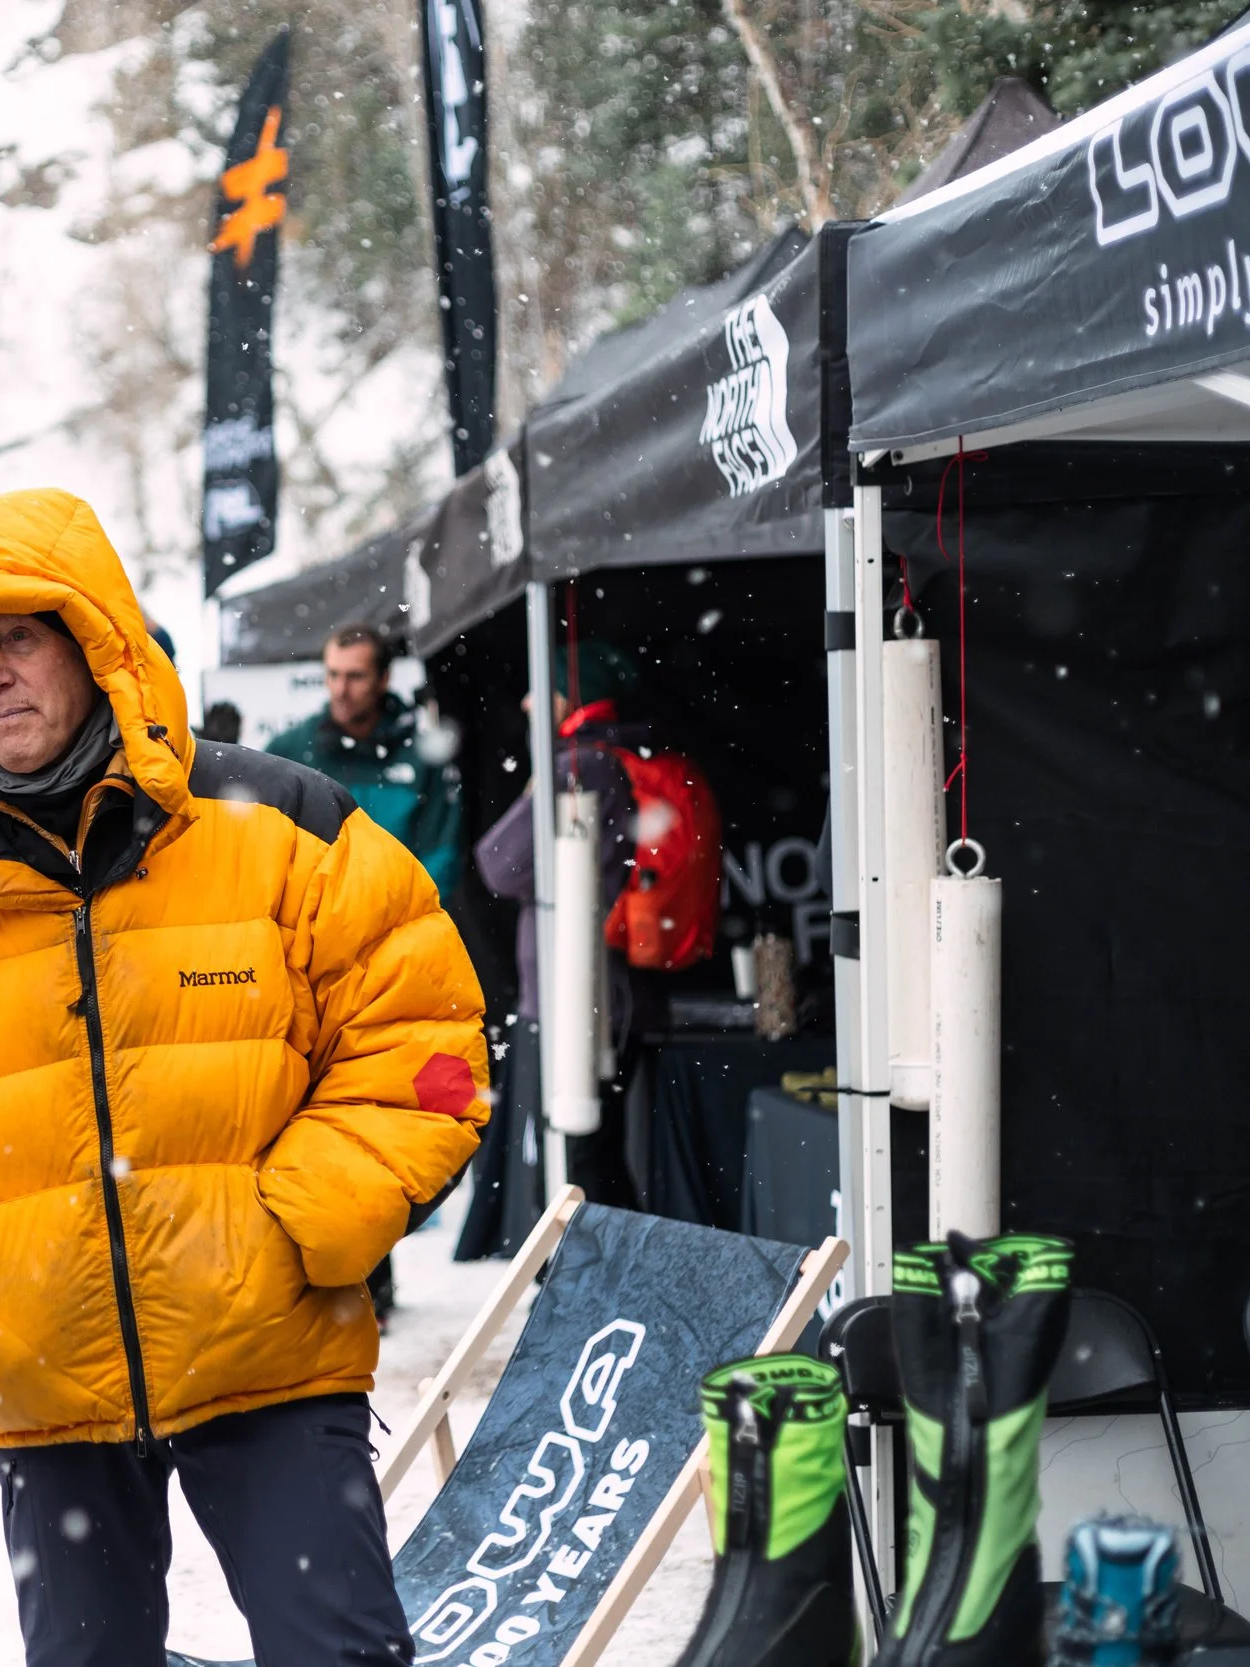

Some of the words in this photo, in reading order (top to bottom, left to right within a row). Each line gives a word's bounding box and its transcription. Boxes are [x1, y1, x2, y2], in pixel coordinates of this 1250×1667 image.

[725, 297, 764, 372] THE
[699, 363, 762, 445] NORTH
[712, 426, 770, 499] FACE
[720, 837, 818, 909] NO
[178, 967, 257, 987] Marmot
[408, 1318, 646, 1666] OWA
[458, 1614, 541, 1667] 00
[521, 1437, 650, 1604] YEARS
